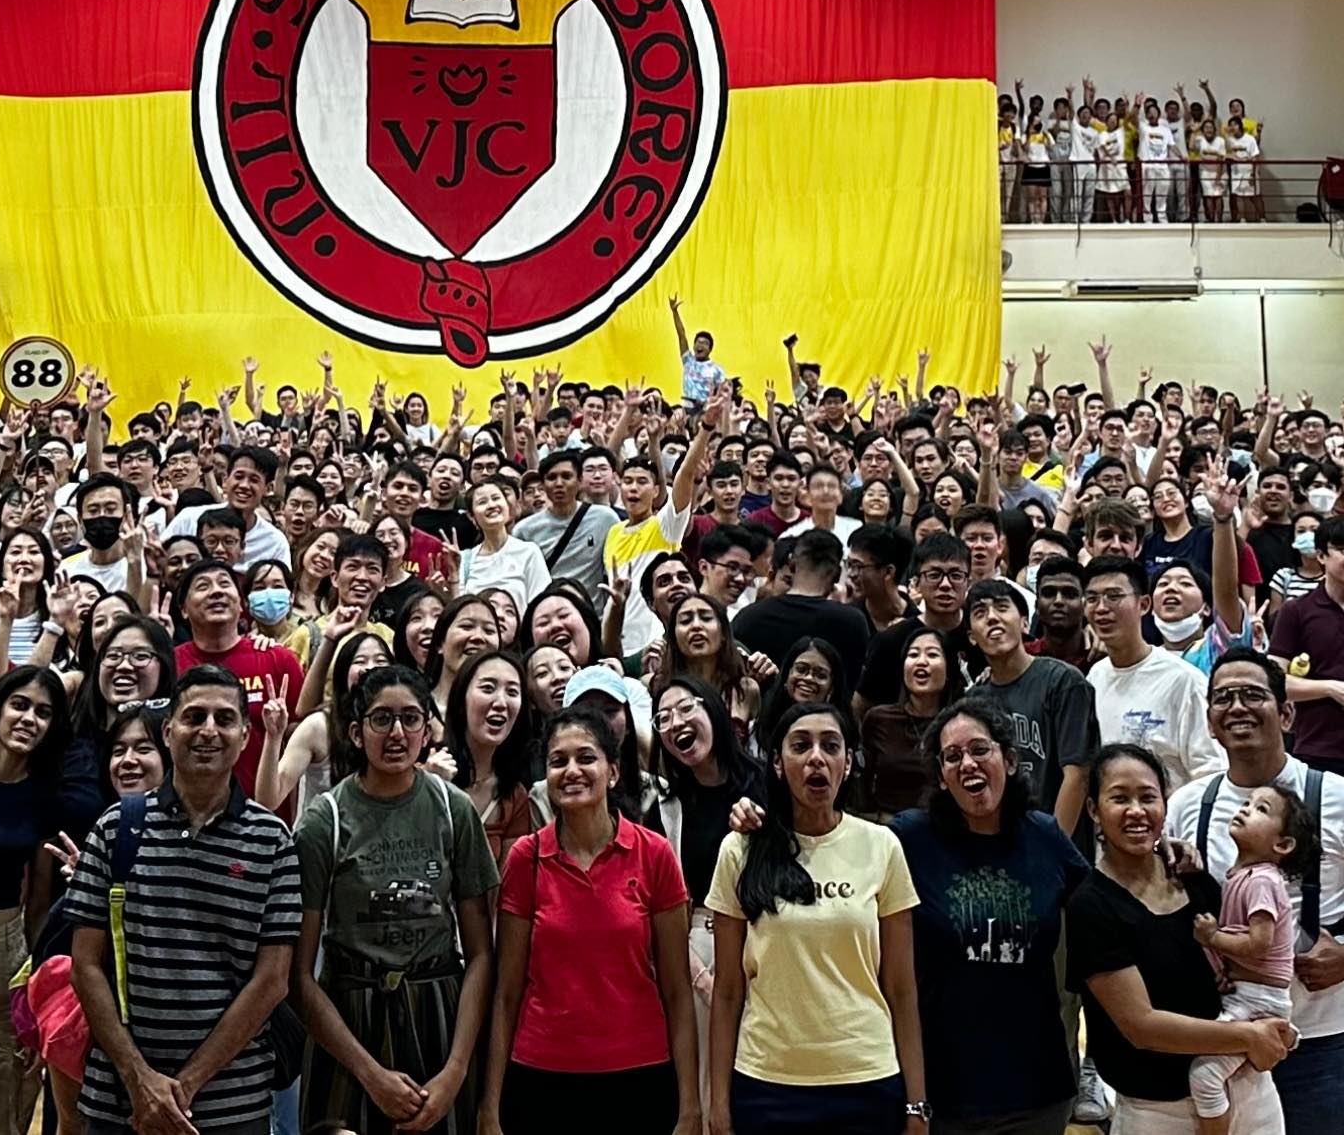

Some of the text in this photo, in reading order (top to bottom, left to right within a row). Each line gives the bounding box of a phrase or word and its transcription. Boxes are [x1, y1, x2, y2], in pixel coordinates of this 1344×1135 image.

[381, 119, 529, 189] VJC
[11, 358, 63, 388] 88
[374, 924, 426, 949] Jeep
